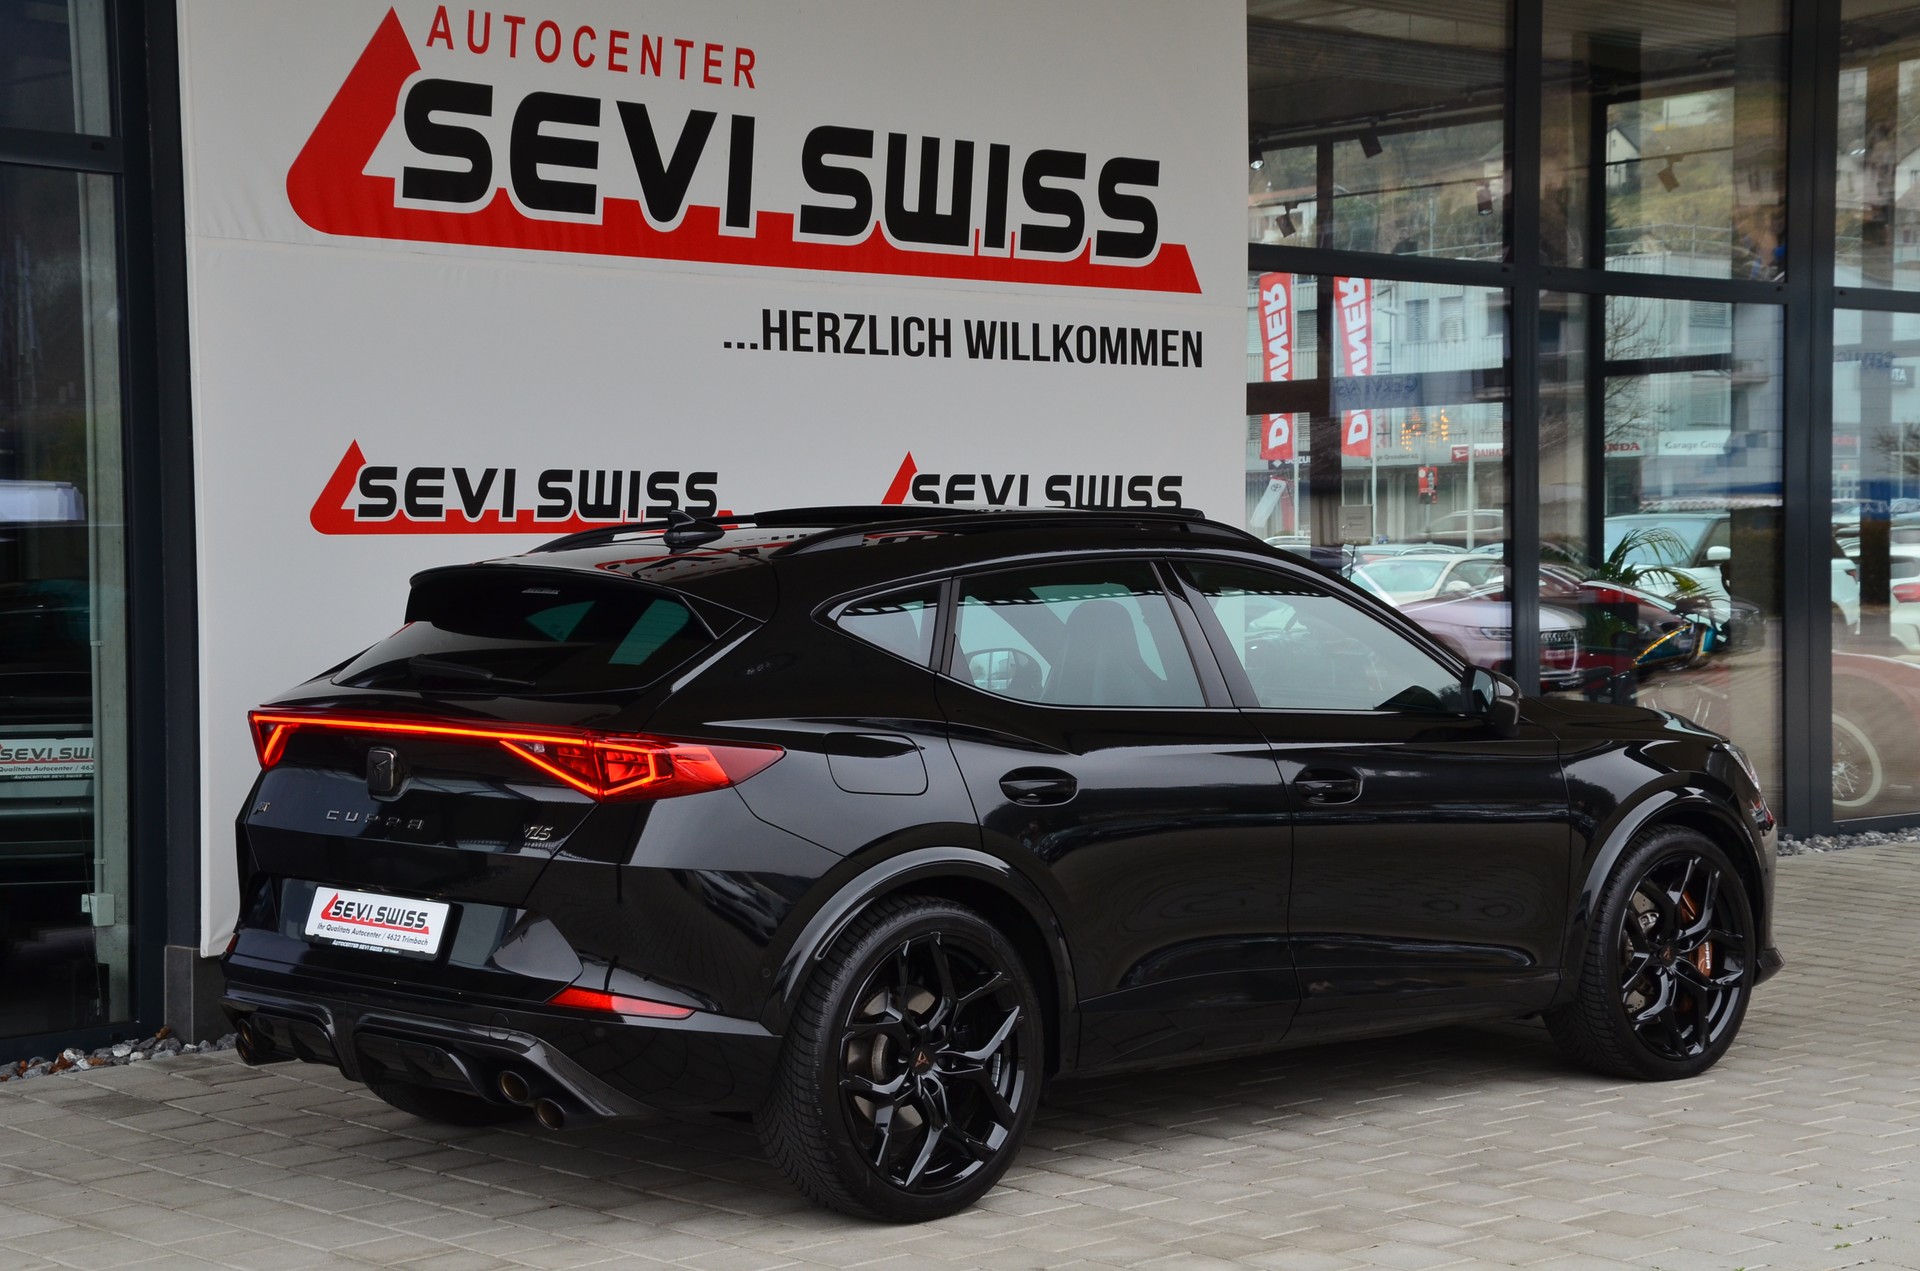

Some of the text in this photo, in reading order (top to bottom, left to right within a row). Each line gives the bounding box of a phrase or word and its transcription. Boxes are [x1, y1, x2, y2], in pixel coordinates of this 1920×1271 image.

[426, 5, 756, 89] AUTOCENTER
[402, 78, 1160, 258] SEVI SWISS
[964, 319, 1202, 368] WILLKOMMEN
[1664, 441, 1698, 451] Garage
[358, 466, 718, 519] SEVI SWISS
[912, 474, 1182, 508] SEVI SWISS
[0, 748, 52, 760] SEVI
[326, 810, 424, 830] CUPRA
[331, 900, 428, 929] SEVI SWISS
[317, 922, 326, 930] Ihr
[326, 924, 351, 935] Qualitats
[351, 928, 381, 939] Autocenter
[386, 933, 401, 942] 4632
[401, 935, 429, 946] Trimbach
